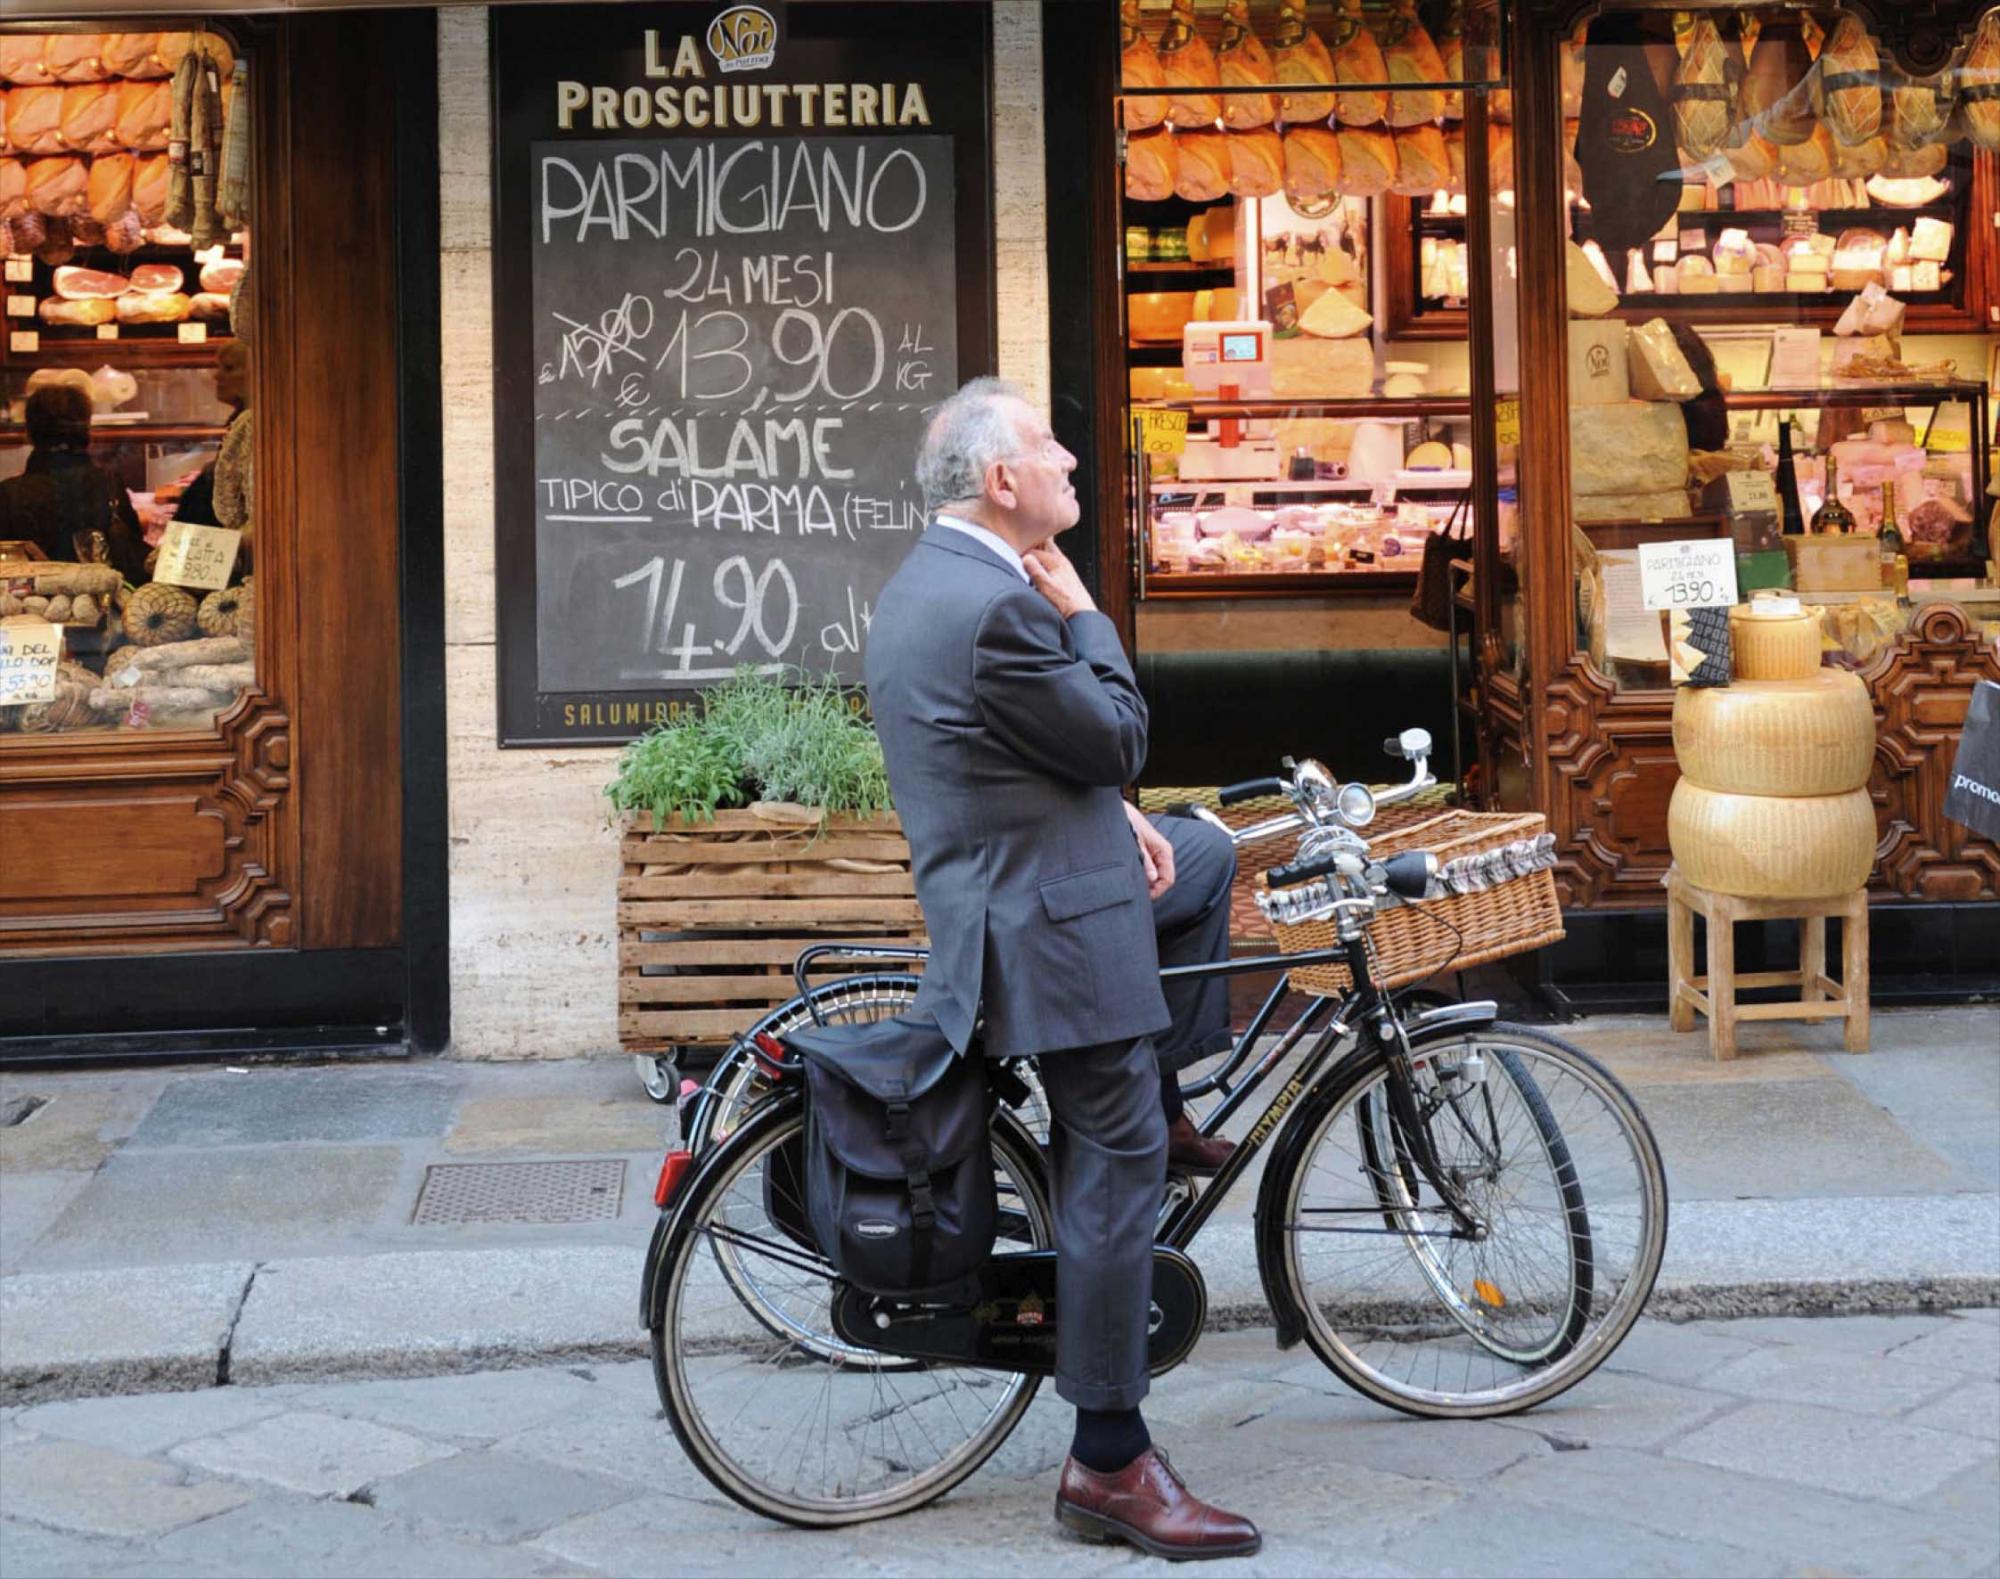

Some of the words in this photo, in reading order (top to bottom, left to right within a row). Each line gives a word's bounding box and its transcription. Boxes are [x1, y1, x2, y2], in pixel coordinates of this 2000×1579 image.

[644, 30, 705, 78] LA
[711, 14, 772, 57] Noi
[541, 140, 927, 243] PARMIGIANO
[665, 248, 731, 305] 24
[742, 251, 833, 306] MESI
[656, 307, 885, 411] 13,90
[898, 323, 933, 353] AL
[896, 360, 933, 391] KG
[601, 417, 855, 479] SALAME
[539, 478, 643, 512] TIPICO
[657, 479, 686, 511] di
[691, 479, 837, 536] PARMA
[843, 491, 933, 541] (FELIN
[1953, 773, 2000, 805] promo
